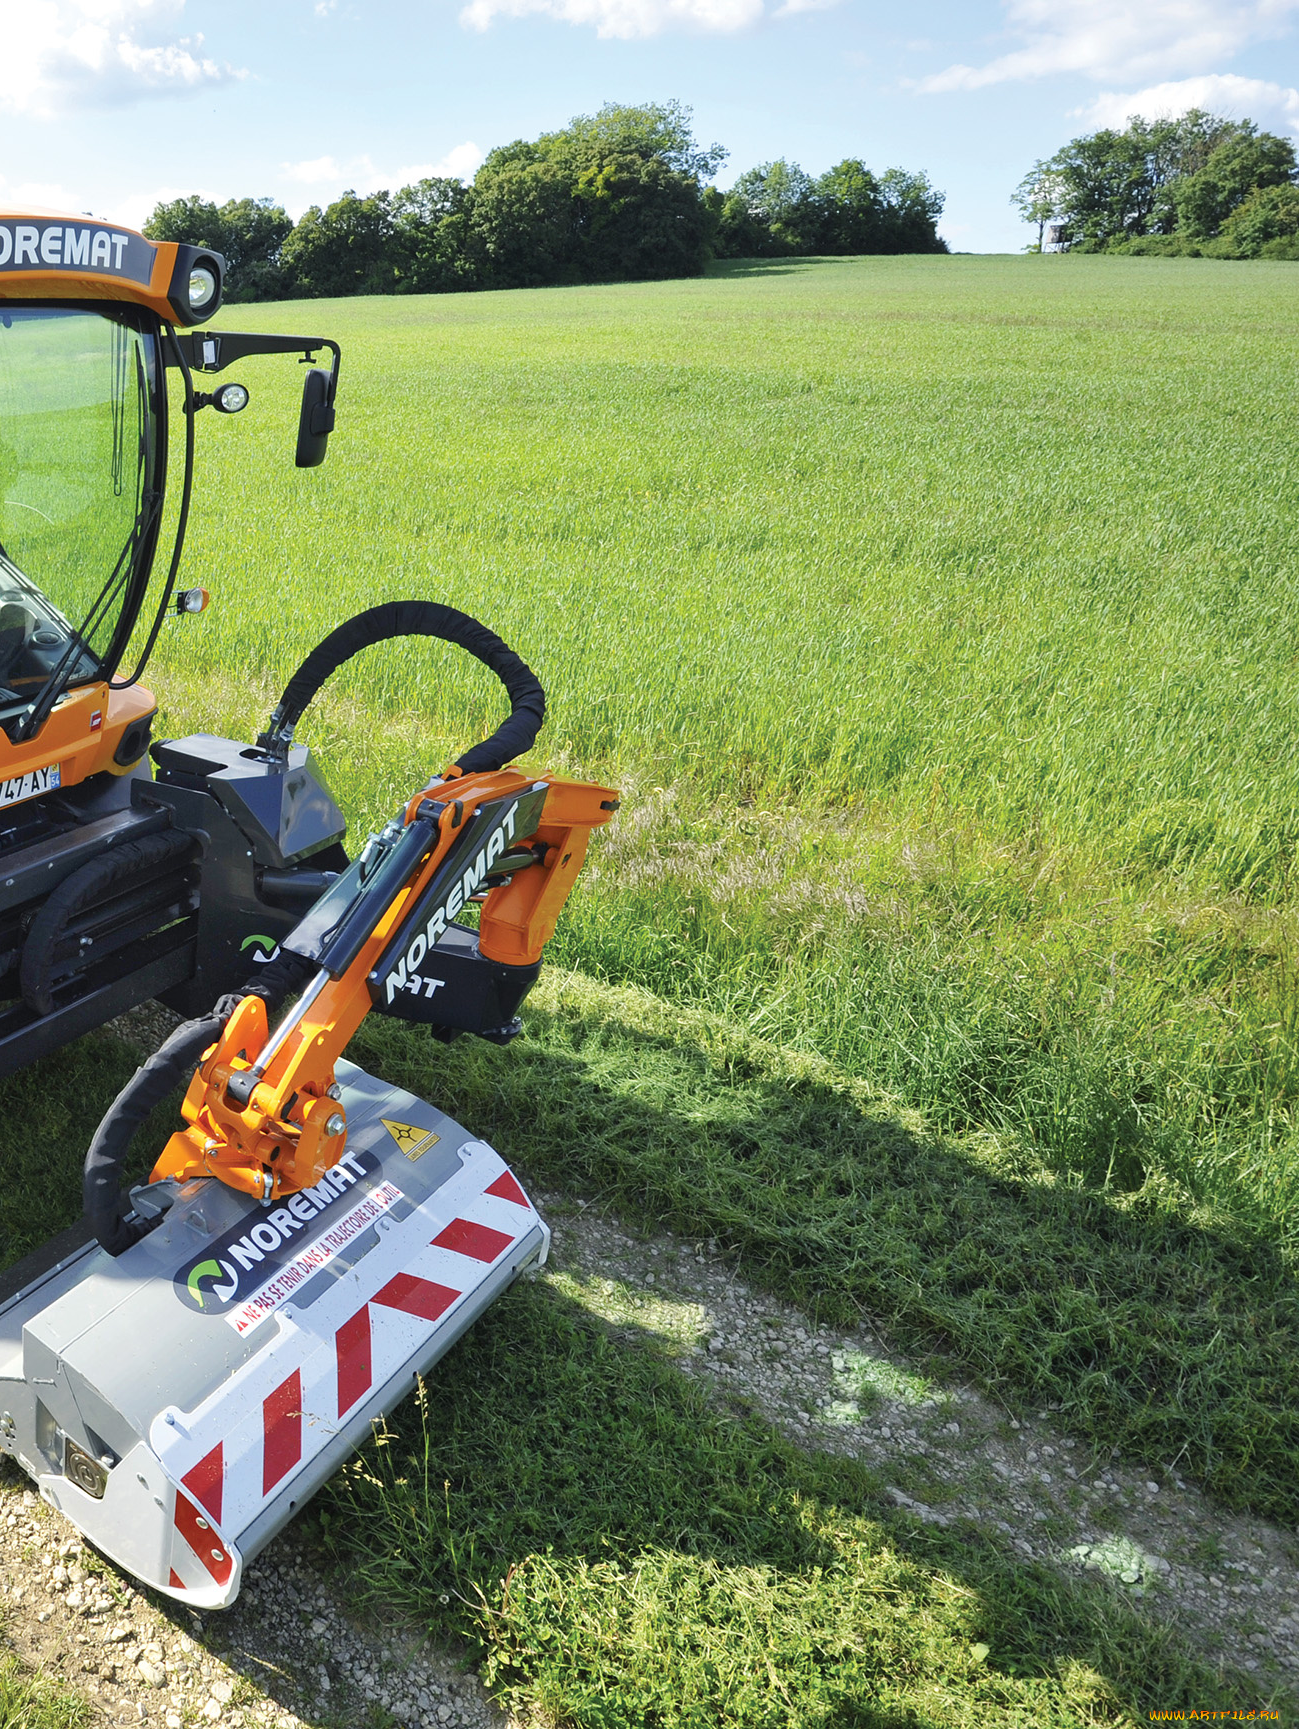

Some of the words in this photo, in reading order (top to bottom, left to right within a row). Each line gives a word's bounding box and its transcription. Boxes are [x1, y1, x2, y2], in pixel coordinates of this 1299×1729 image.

[51, 774, 60, 787] 54
[385, 801, 519, 1004] NOREMAT
[227, 1151, 367, 1271] NOREMAT
[242, 1305, 261, 1323] NE
[252, 1292, 276, 1312] PAS
[267, 1284, 285, 1300] SE
[276, 1266, 305, 1291] TENIR
[298, 1250, 324, 1275] DANS
[318, 1243, 331, 1258] LA
[325, 1209, 371, 1249] TRAJECTOIRE
[365, 1201, 379, 1218] DE
